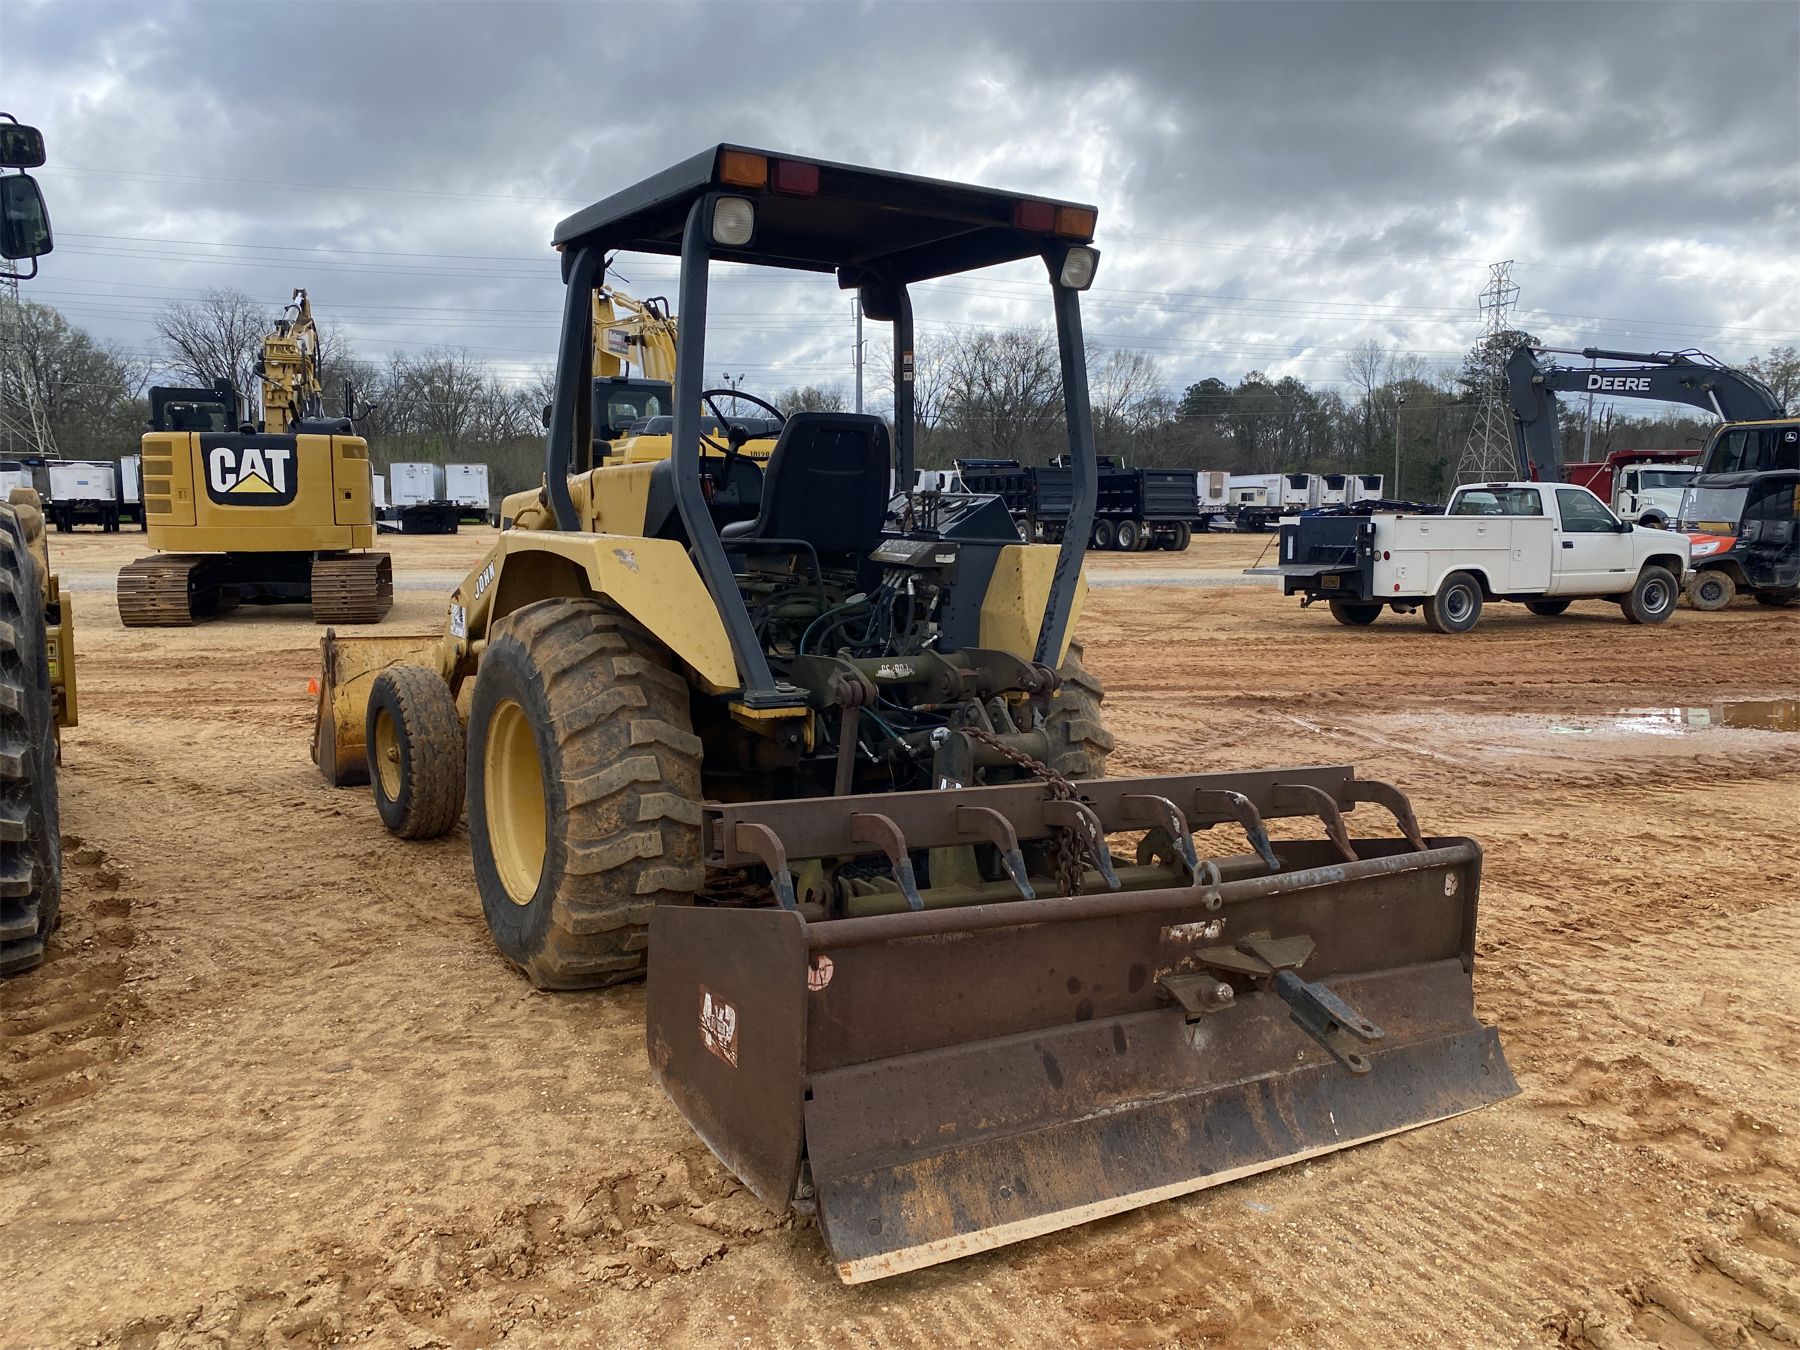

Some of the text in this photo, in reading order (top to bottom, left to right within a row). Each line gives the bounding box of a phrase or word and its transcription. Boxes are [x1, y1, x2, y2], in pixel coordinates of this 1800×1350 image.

[1587, 374, 1652, 391] DEERE
[209, 447, 290, 493] CAT
[474, 560, 495, 600] JOHN
